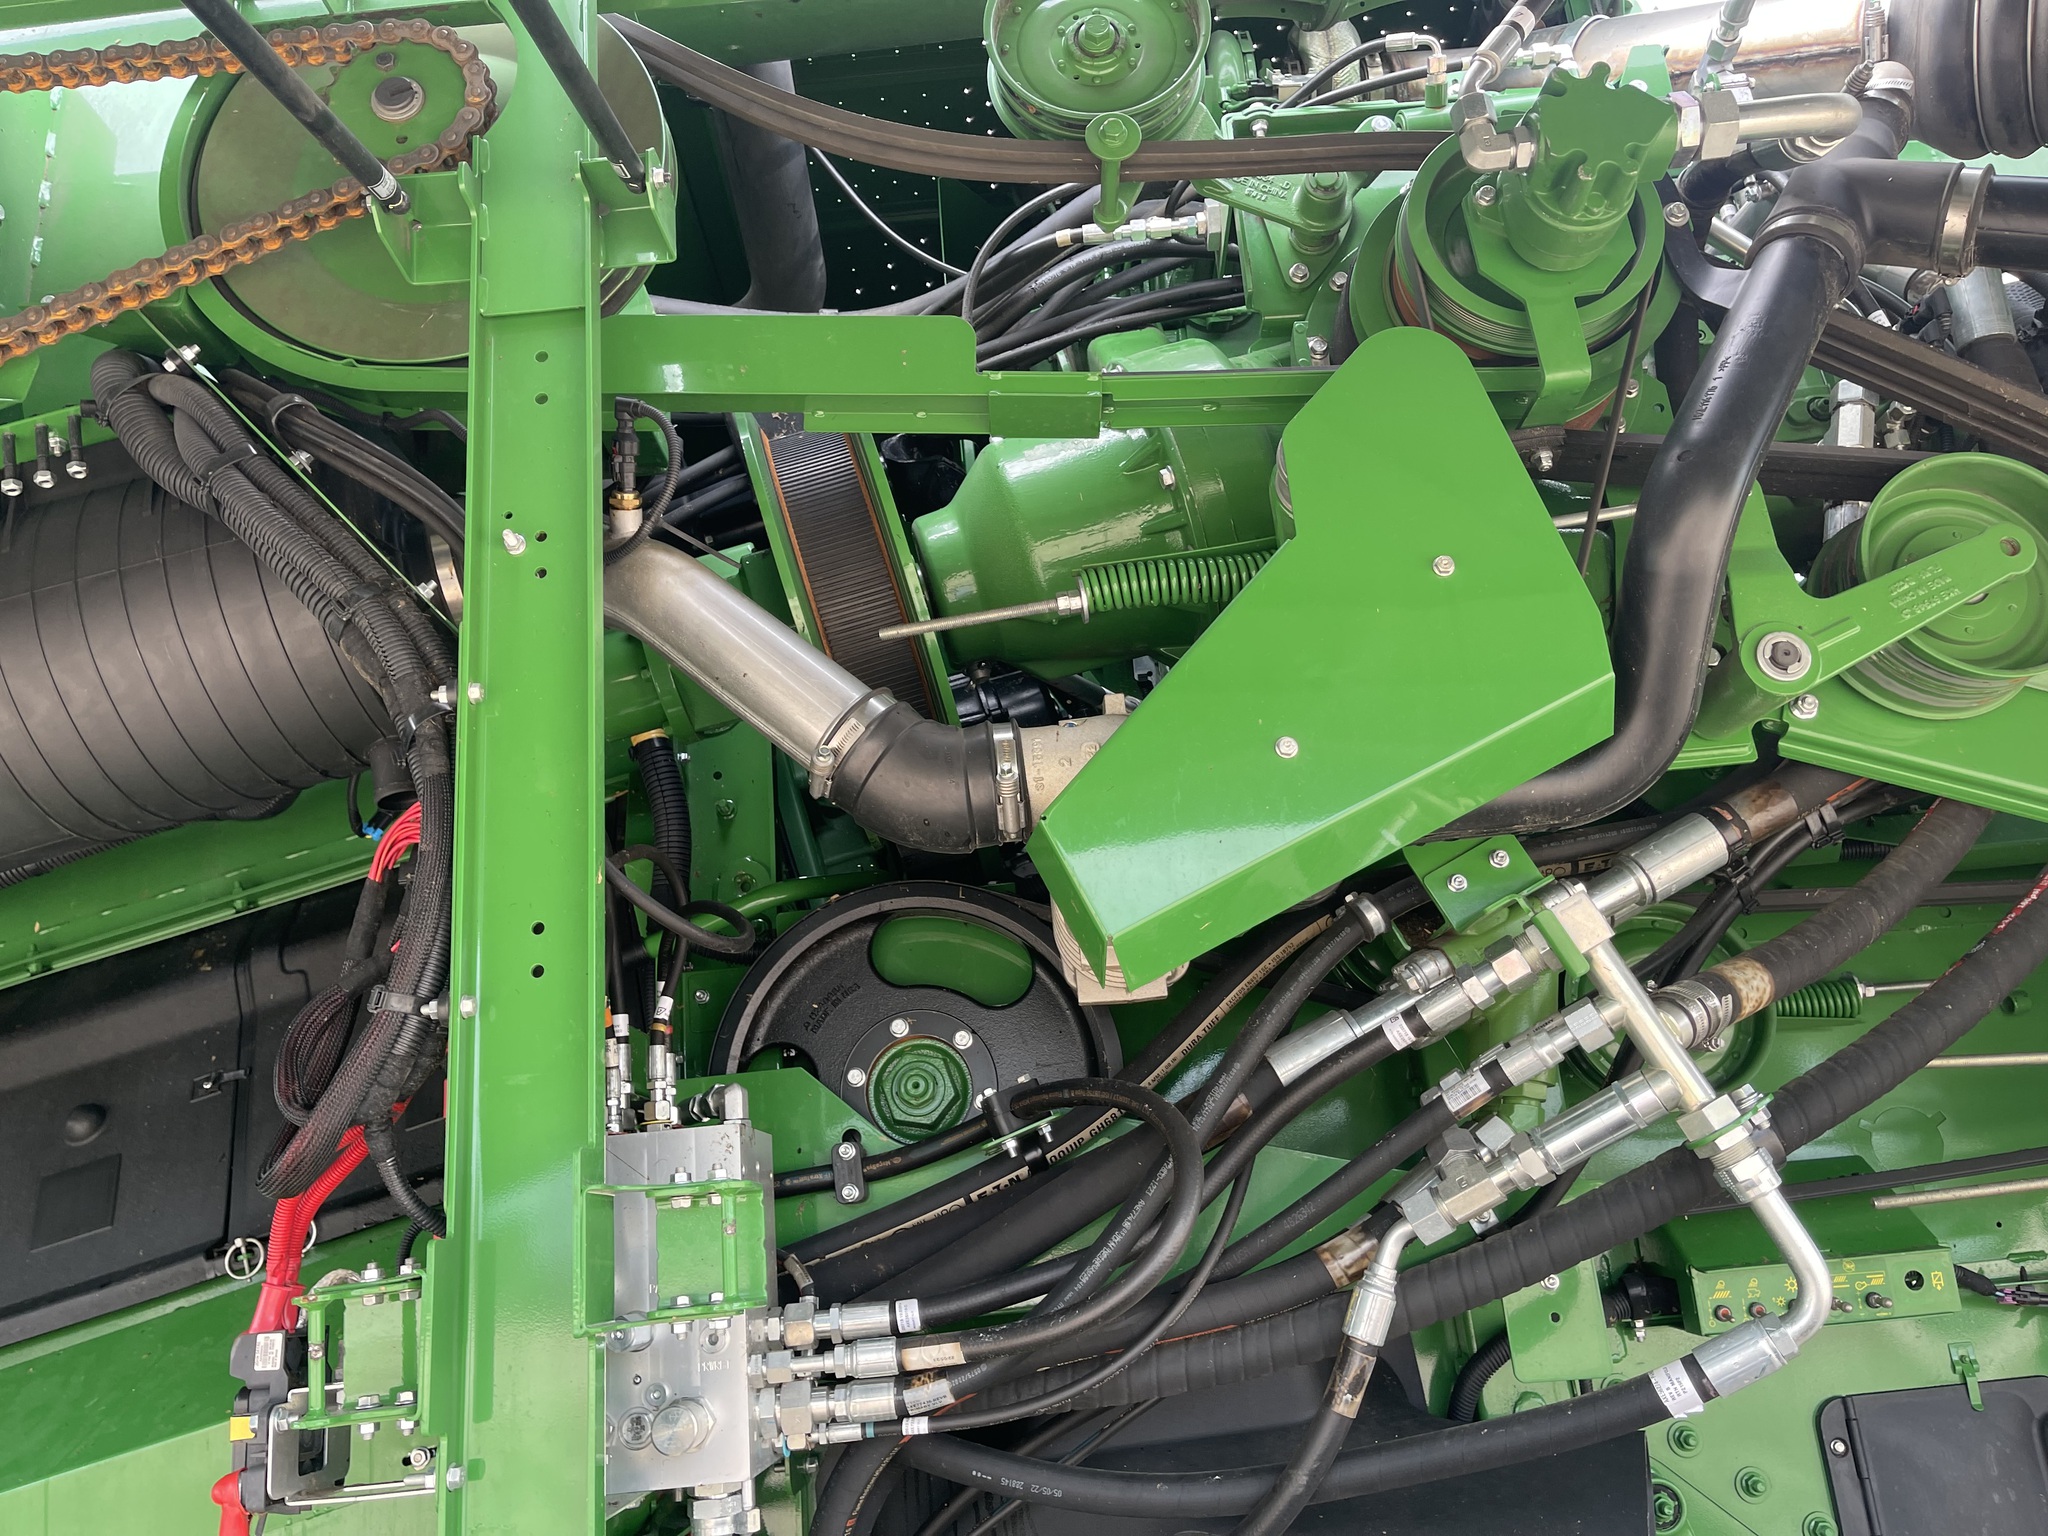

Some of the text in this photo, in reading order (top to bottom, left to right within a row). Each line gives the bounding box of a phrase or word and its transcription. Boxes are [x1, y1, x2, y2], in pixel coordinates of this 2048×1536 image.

[1225, 986, 1247, 1006] EXCEEDS
[1667, 1391, 1675, 1401] REV
[1000, 1477, 1062, 1498] 05/05/22 288145
